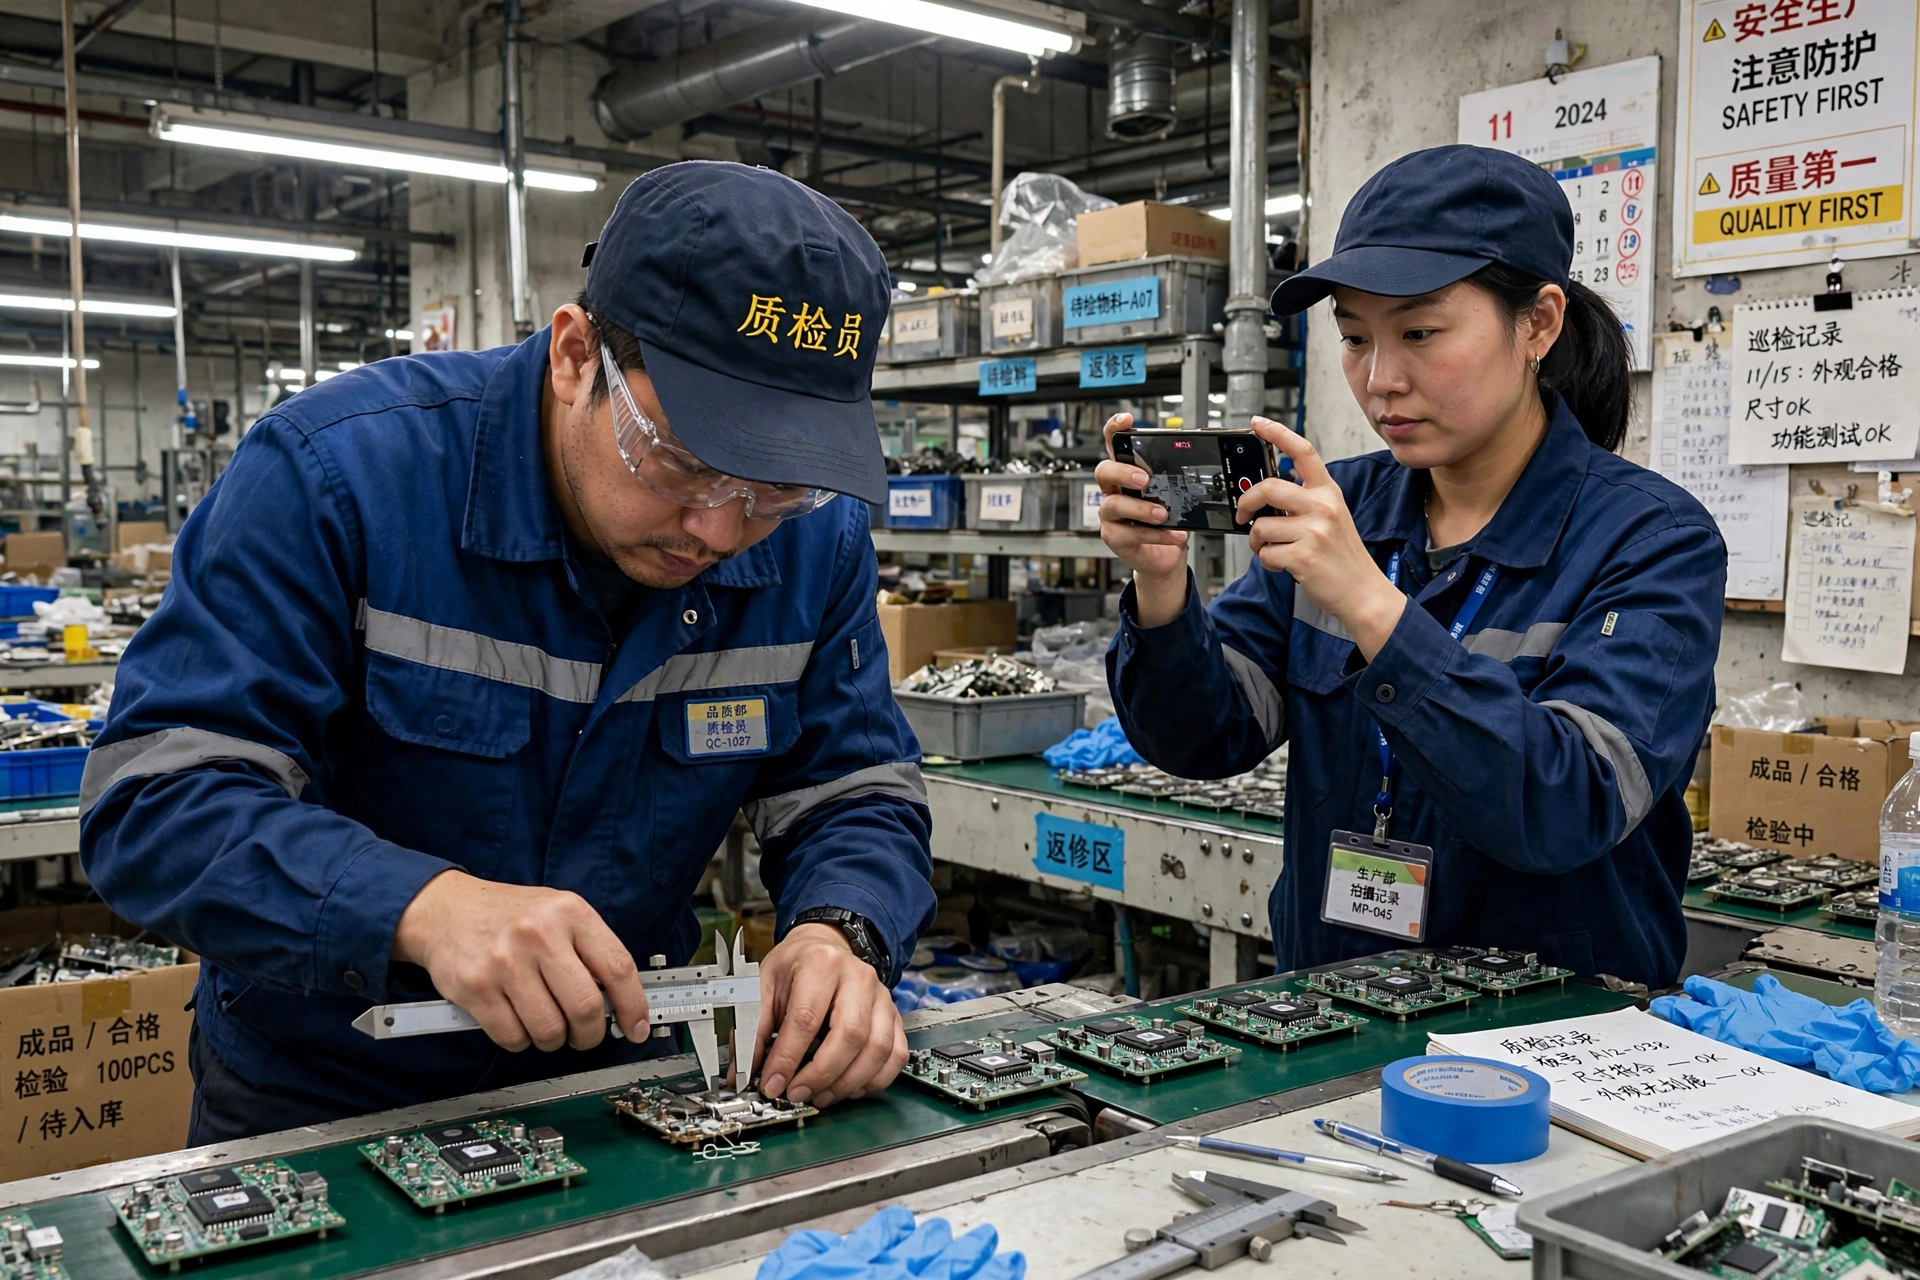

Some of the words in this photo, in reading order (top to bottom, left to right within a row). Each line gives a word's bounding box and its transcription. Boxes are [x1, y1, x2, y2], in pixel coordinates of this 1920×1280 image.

[1731, 29, 1877, 93] 注意防护
[1554, 98, 1608, 129] 2024
[1722, 91, 1809, 130] SAFETY
[1816, 77, 1884, 114] FIRST
[1488, 110, 1513, 141] 11
[1601, 180, 1610, 194] 2
[1728, 149, 1877, 199] 质量第一
[1719, 201, 1812, 236] QUALITY
[1819, 191, 1884, 223] FIRST
[736, 294, 862, 360] 质检员
[1747, 321, 1844, 352] 巡检记录
[1088, 353, 1136, 379] 返修区
[706, 704, 748, 719] 品质部
[705, 735, 751, 750] QC-1027
[706, 719, 748, 736] 质检员
[1749, 756, 1792, 784] 成品
[1815, 763, 1861, 792] 合格
[1745, 816, 1815, 848] 检验中
[1046, 830, 1113, 875] 返修区
[1357, 866, 1397, 886] 生产部
[1352, 902, 1393, 921] MP-045
[16, 1025, 74, 1060] 成品
[107, 1011, 161, 1046] 合格
[1694, 1053, 1728, 1064] OK
[1740, 1065, 1776, 1077] OK
[14, 1065, 69, 1100] 检验
[97, 1051, 175, 1084] 100PCS
[39, 1100, 124, 1141] 待入库
